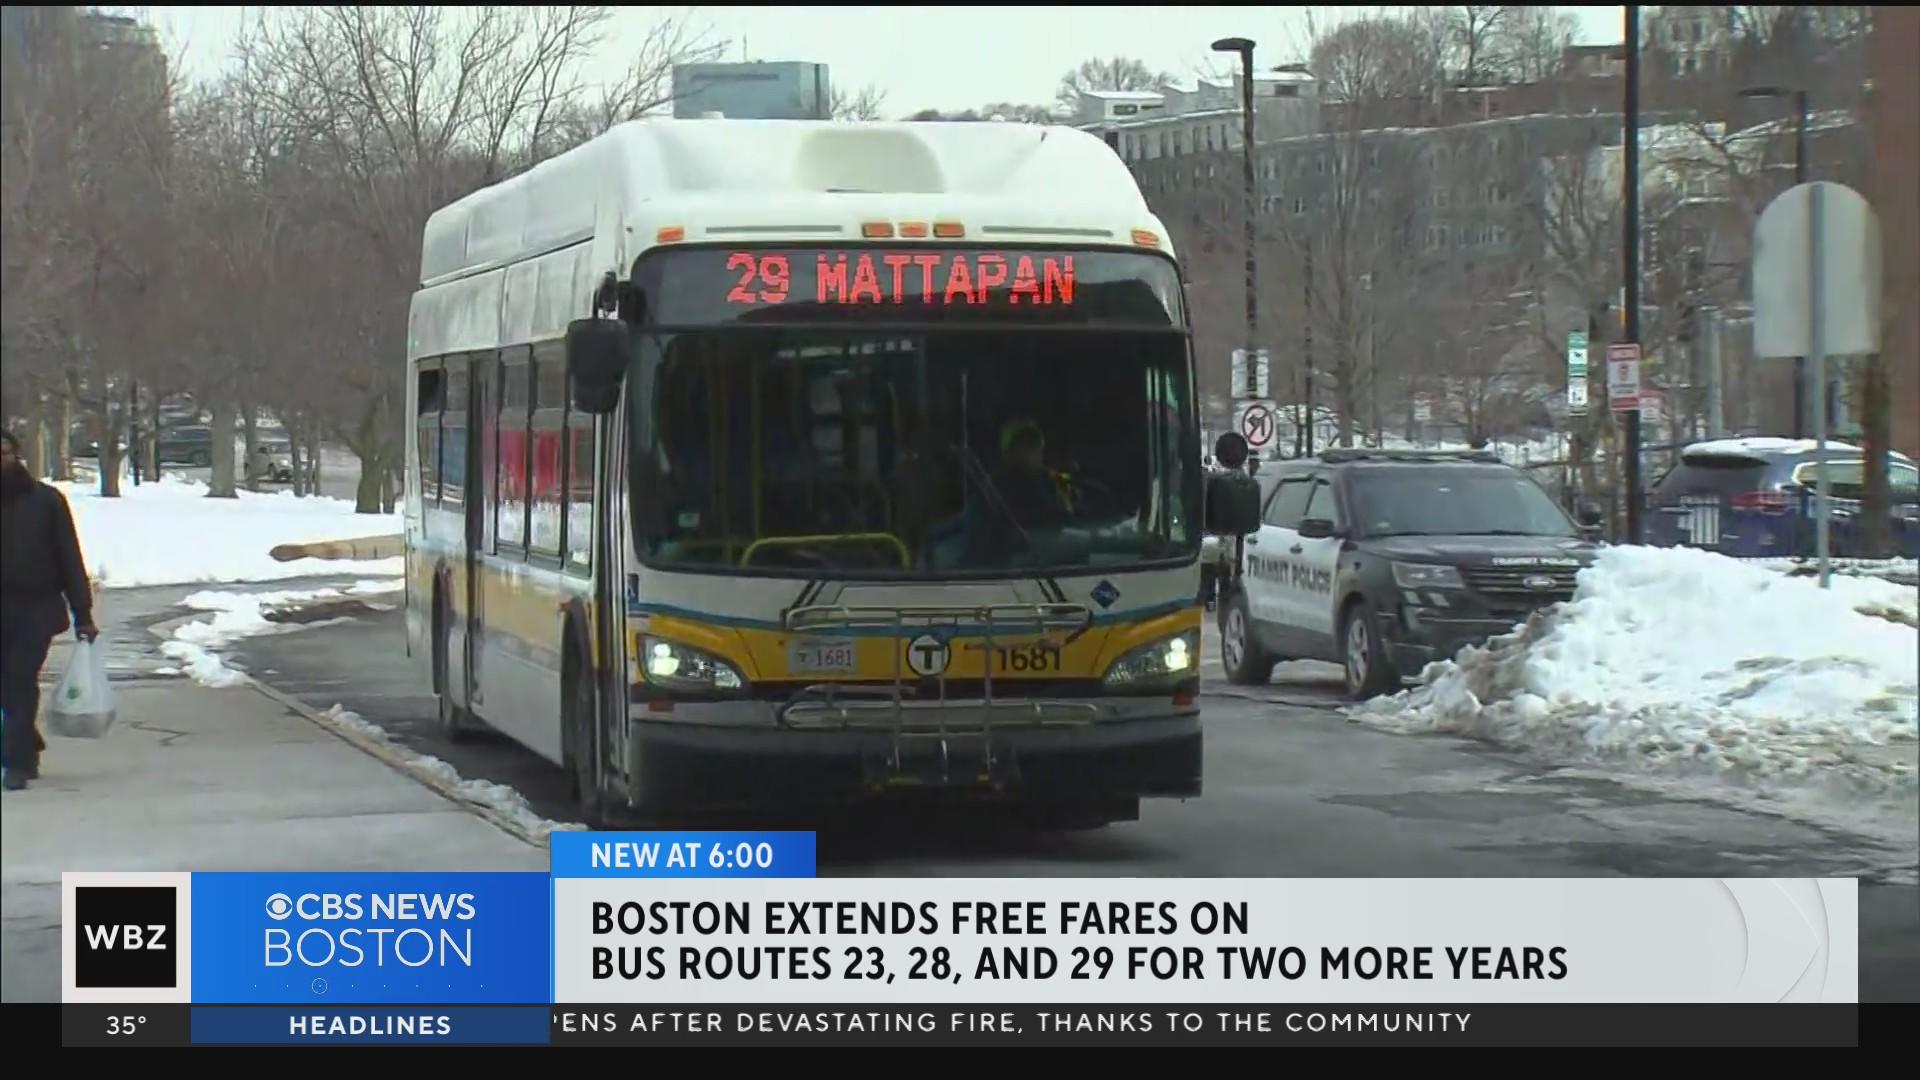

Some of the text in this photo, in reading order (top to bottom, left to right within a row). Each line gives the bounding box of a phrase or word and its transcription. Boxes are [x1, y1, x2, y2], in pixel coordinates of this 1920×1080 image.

[726, 253, 1074, 304] 29 MATTAPAN
[816, 650, 853, 667] 1681
[999, 645, 1061, 671] 1681
